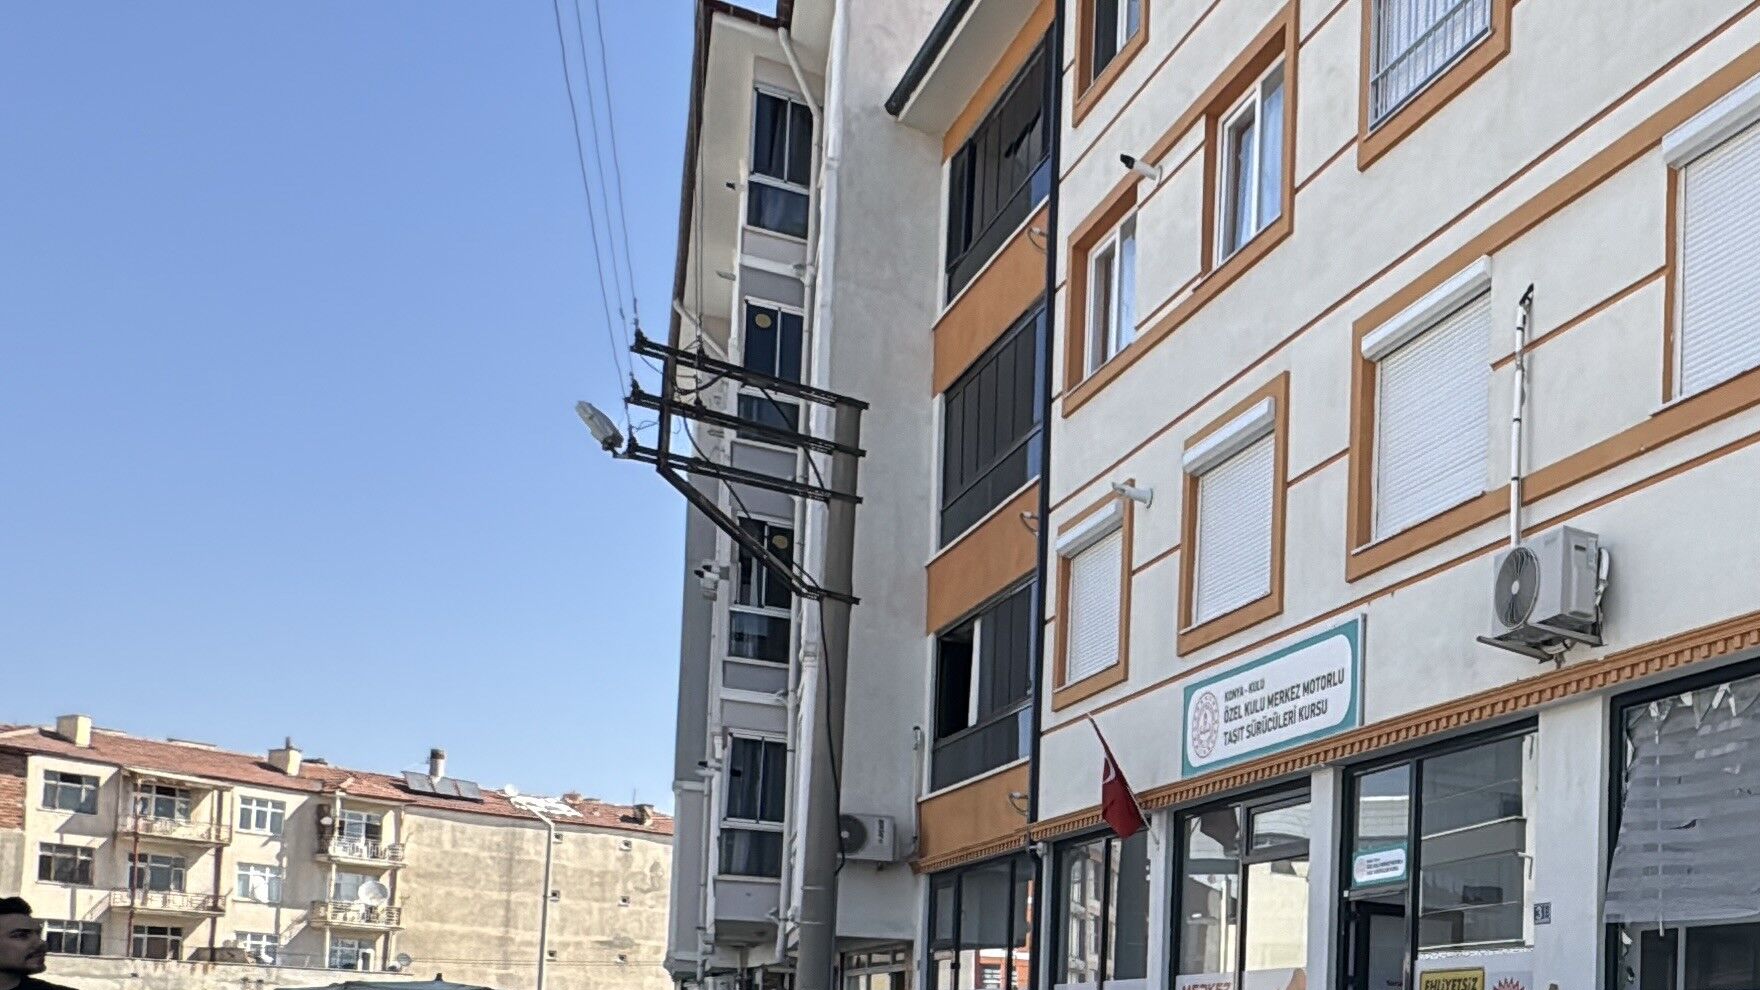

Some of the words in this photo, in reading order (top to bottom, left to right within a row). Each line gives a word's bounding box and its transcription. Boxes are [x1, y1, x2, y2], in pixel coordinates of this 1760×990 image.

[1223, 704, 1243, 724] ÖZEL
[1244, 699, 1266, 717] KULU
[1267, 684, 1301, 711] MERKEZ
[1302, 668, 1345, 698] MOTORLU
[1224, 687, 1244, 702] KONYA
[1248, 677, 1265, 695] KULU
[1223, 725, 1246, 747] TAŞIT
[1245, 706, 1297, 738] SÜRÜCÜLERİ
[1298, 698, 1328, 724] KURSU
